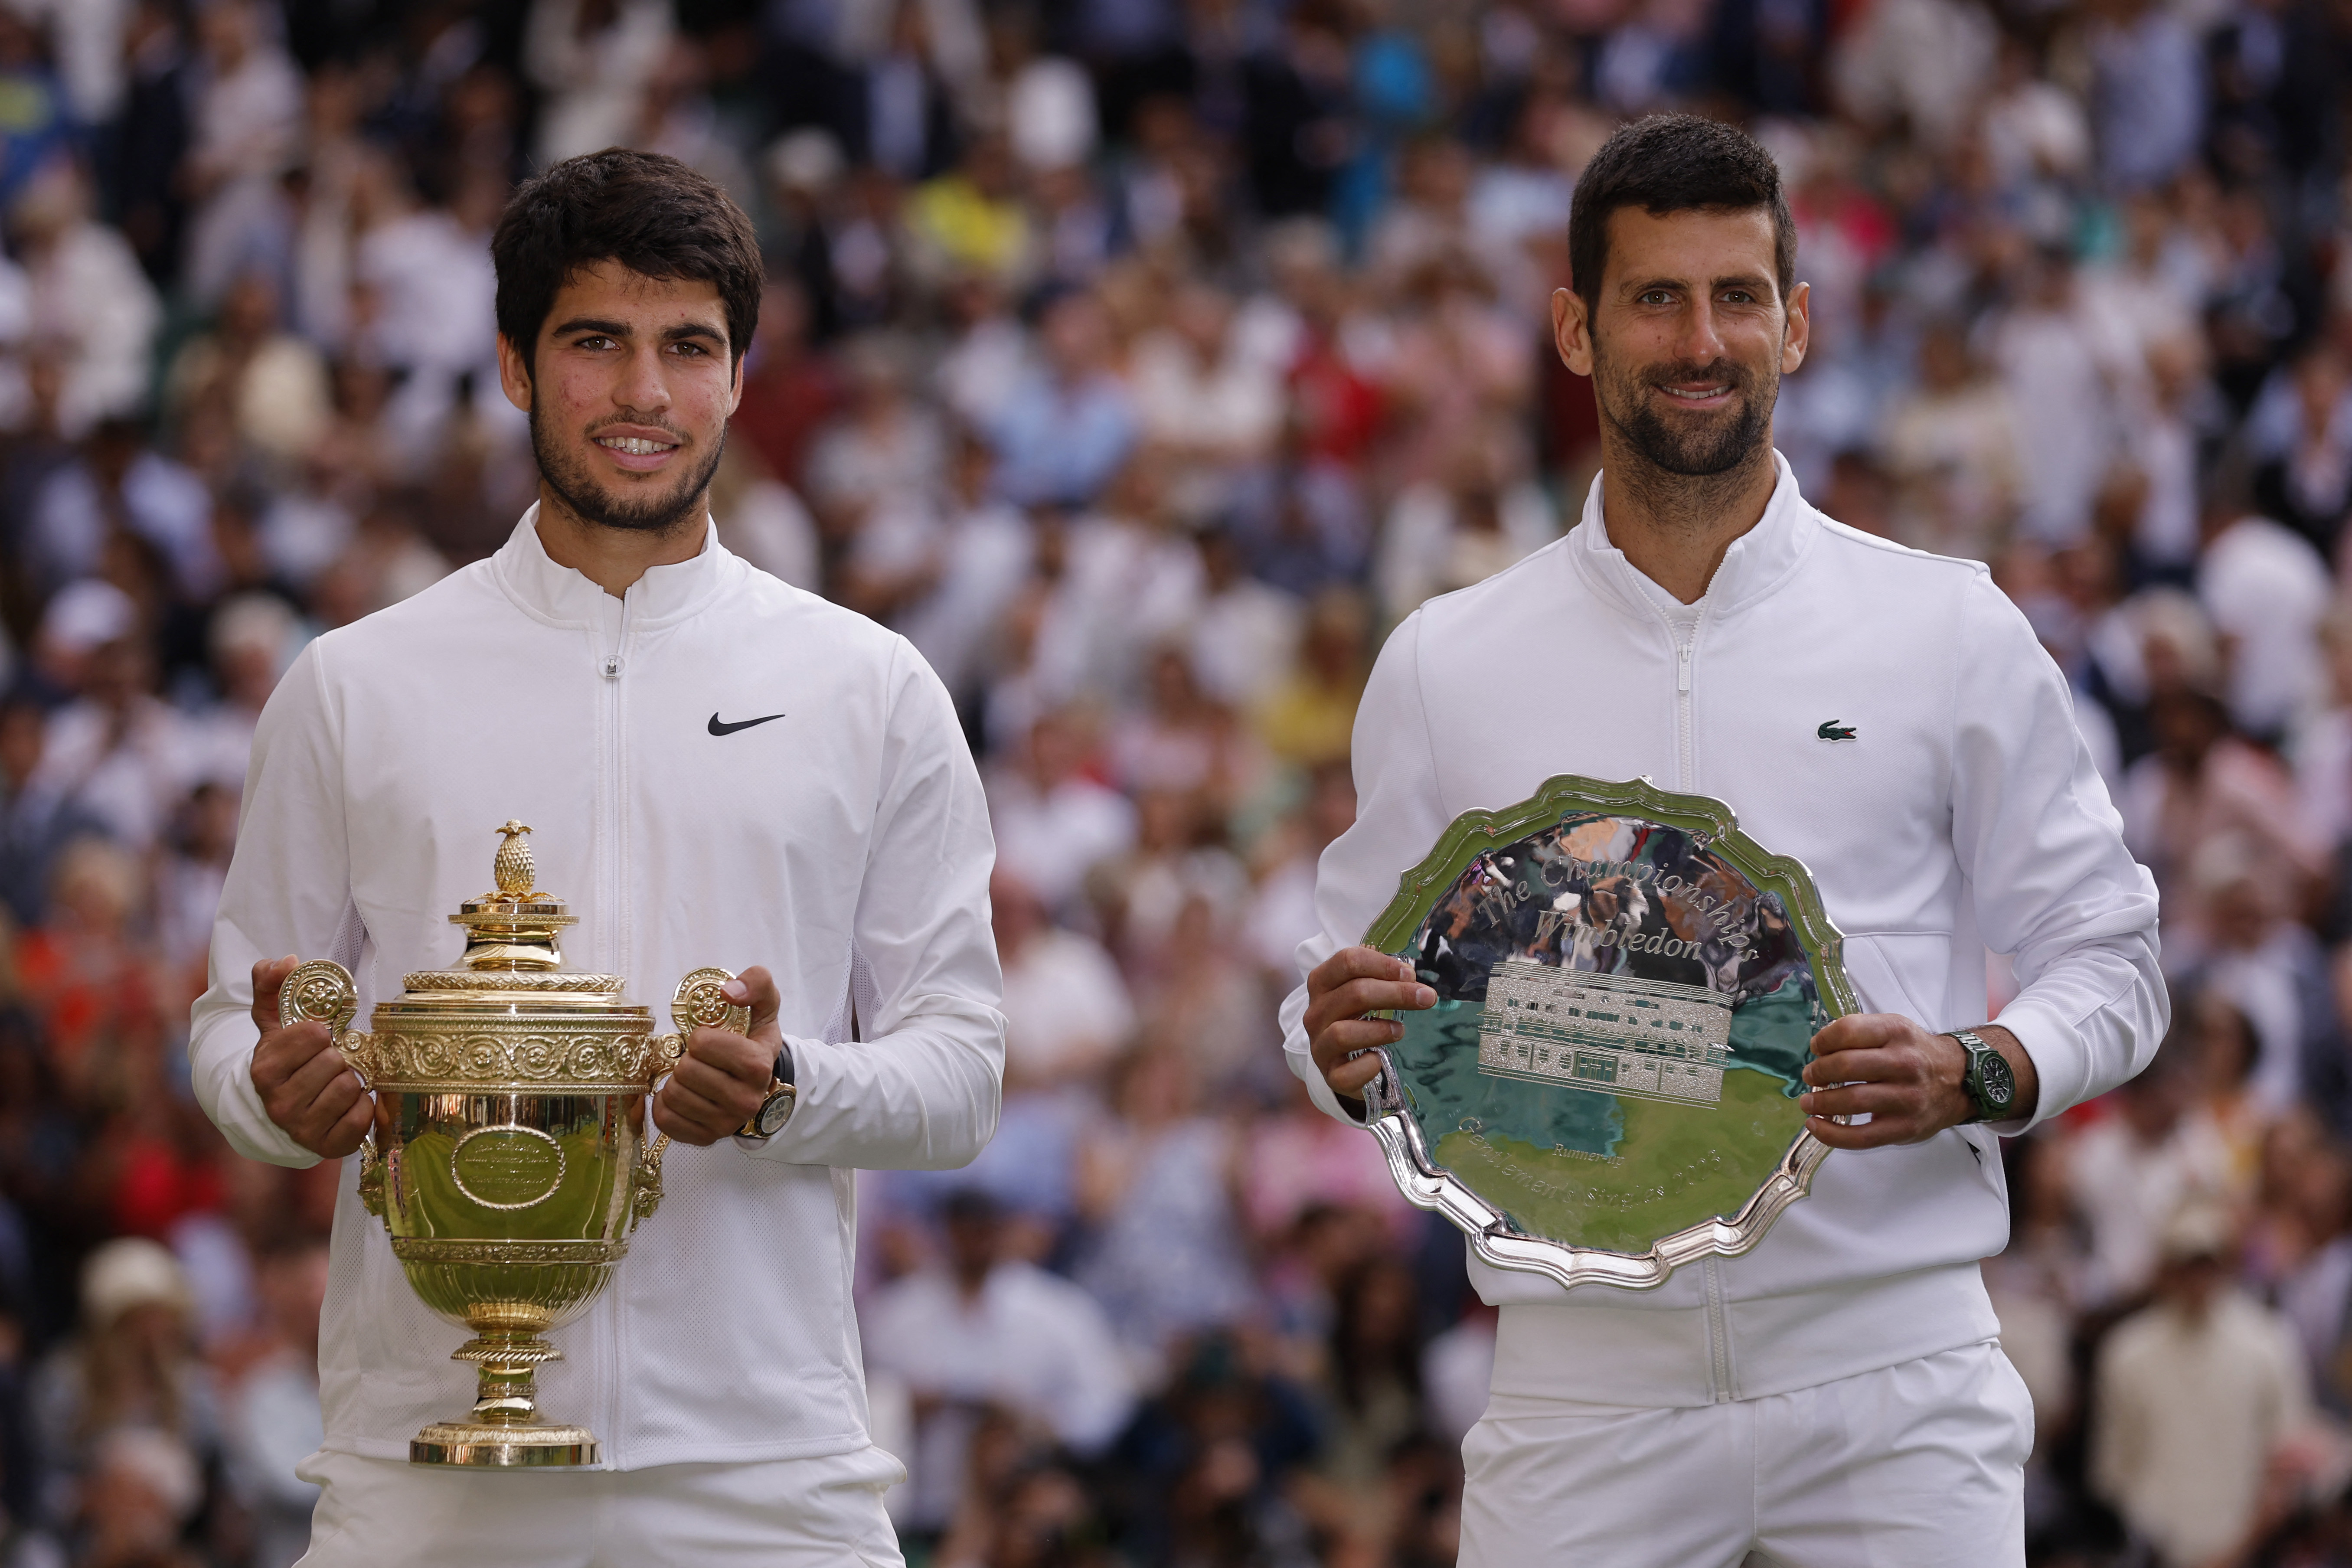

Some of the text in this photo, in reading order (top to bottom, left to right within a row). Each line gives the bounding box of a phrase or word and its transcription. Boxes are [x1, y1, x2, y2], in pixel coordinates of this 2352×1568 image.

[1476, 853, 1760, 962] The Championships
[1535, 910, 1702, 960] Wimbledon
[1458, 1116, 1575, 1203] Gentlemen's
[1552, 1143, 1625, 1168] Runner-up
